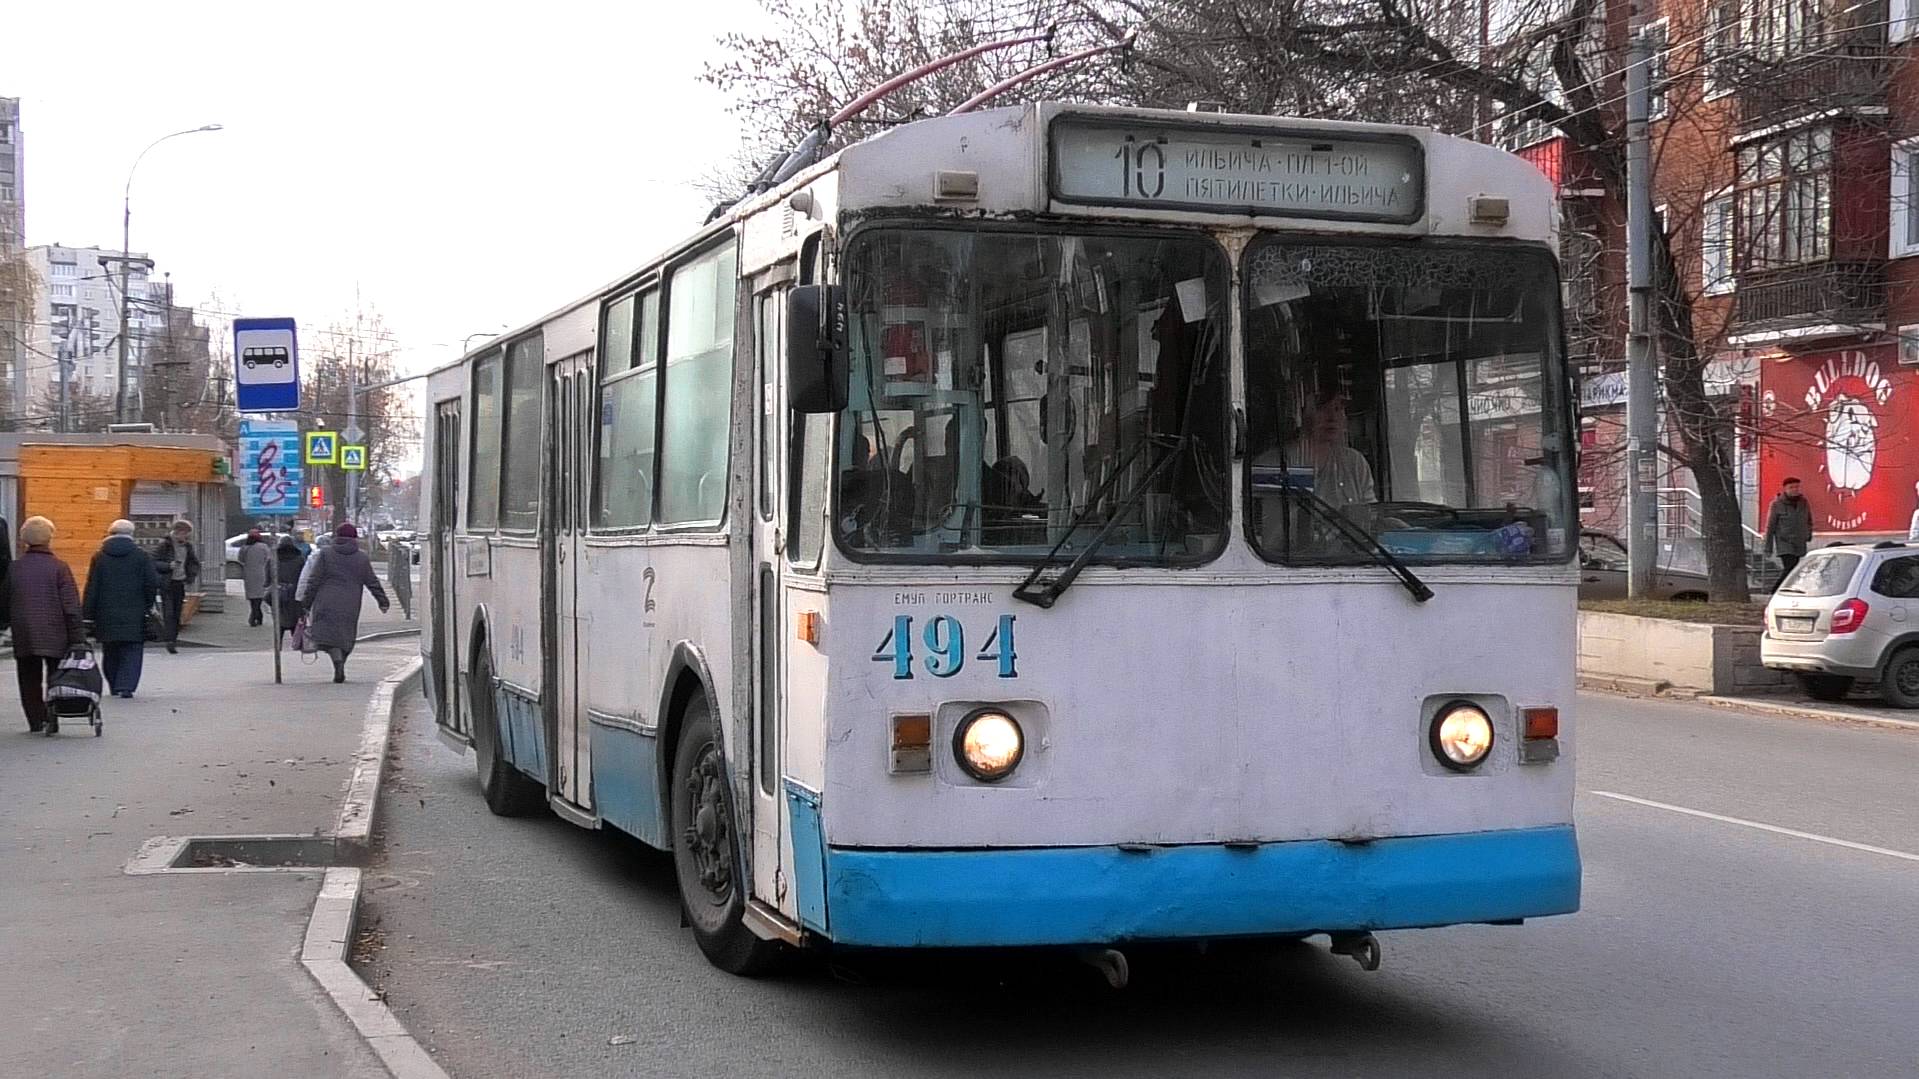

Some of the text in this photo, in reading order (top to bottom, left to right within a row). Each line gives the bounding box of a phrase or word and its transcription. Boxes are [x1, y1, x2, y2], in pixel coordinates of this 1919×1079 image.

[1115, 142, 1164, 198] 10
[1186, 149, 1271, 172] ИЛЬИЧА
[1186, 177, 1400, 206] ПЯТИЛЕТКИ ИЛЬИЧА
[1804, 351, 1893, 411] BULLDOG
[643, 567, 656, 613] 2
[895, 592, 993, 605] ЕМУП ГОРТРАНС
[872, 614, 1018, 680] 494
